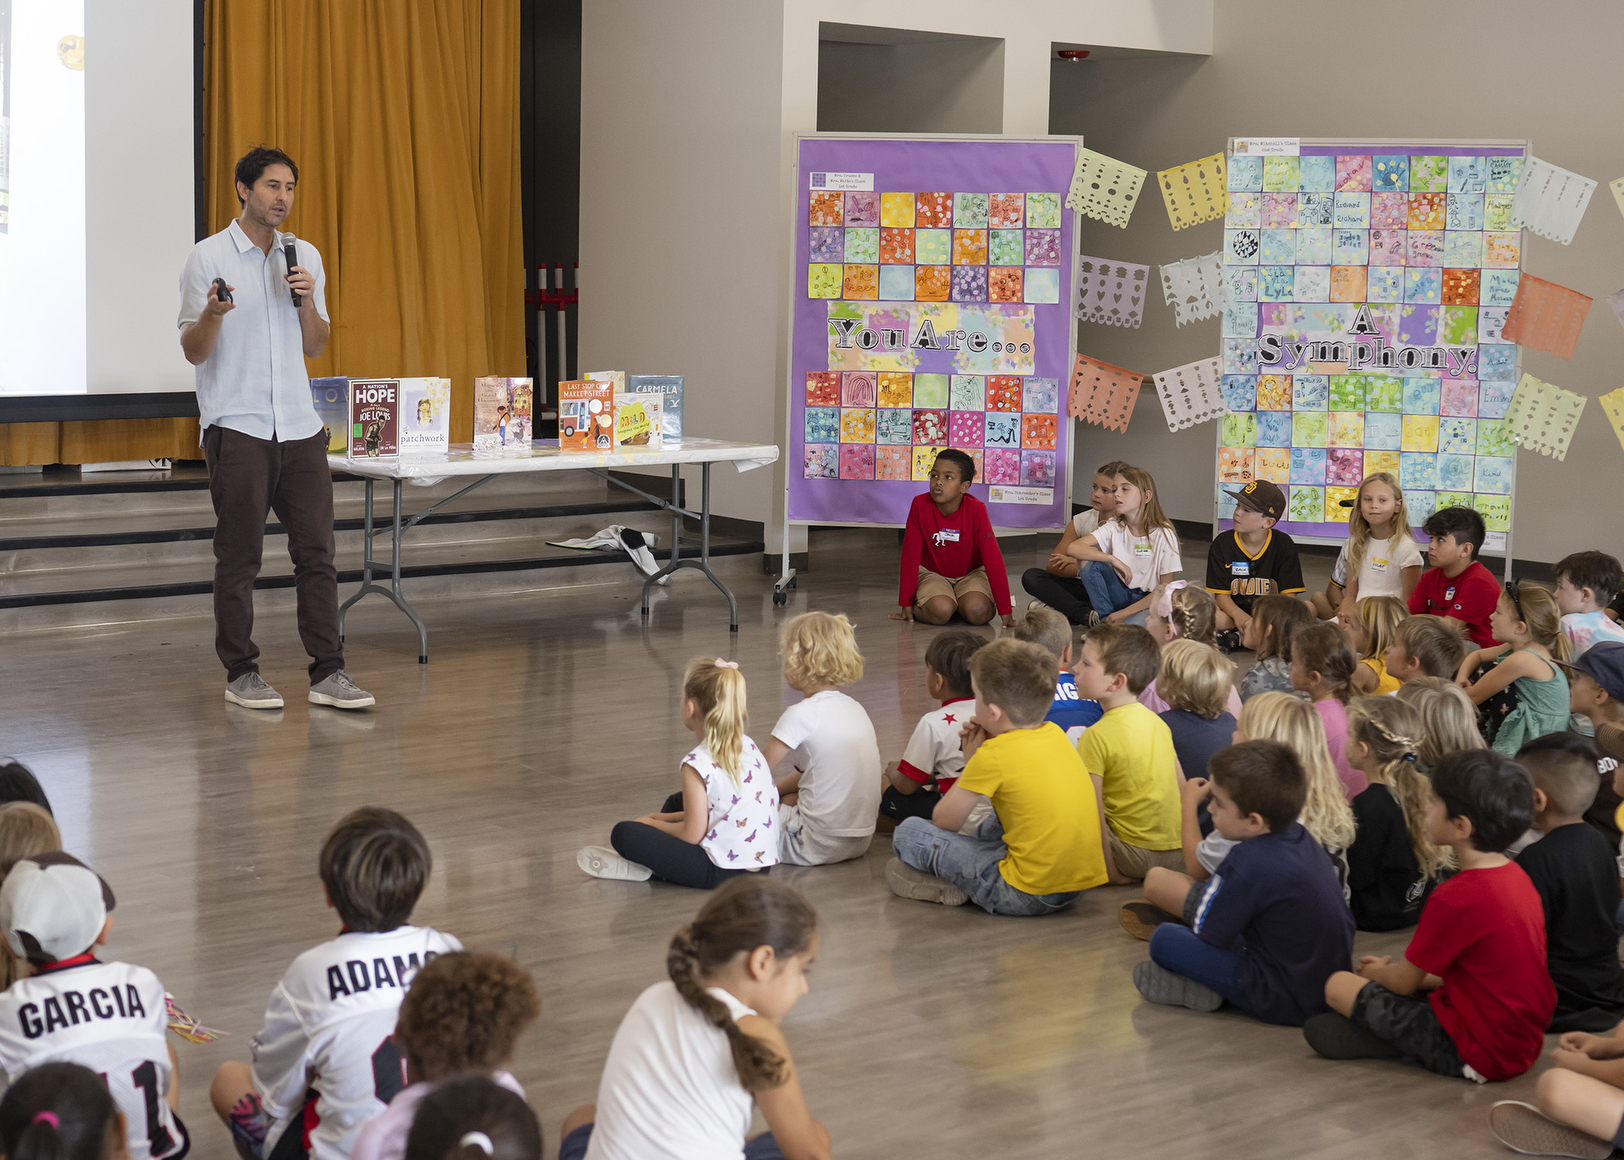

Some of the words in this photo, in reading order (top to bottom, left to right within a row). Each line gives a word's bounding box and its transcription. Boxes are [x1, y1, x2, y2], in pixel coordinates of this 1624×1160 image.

[1348, 304, 1380, 335] A
[828, 318, 906, 350] You
[910, 319, 1031, 353] Are...
[1257, 333, 1479, 377] Symphony.
[355, 388, 395, 404] HOPE
[563, 390, 588, 398] MARKET
[588, 389, 610, 398] STREET
[636, 385, 678, 395] CARMELA
[359, 411, 371, 422] JOE
[400, 433, 445, 445] patchwork
[327, 950, 440, 1001] ADAM
[18, 983, 147, 1040] GARCIA
